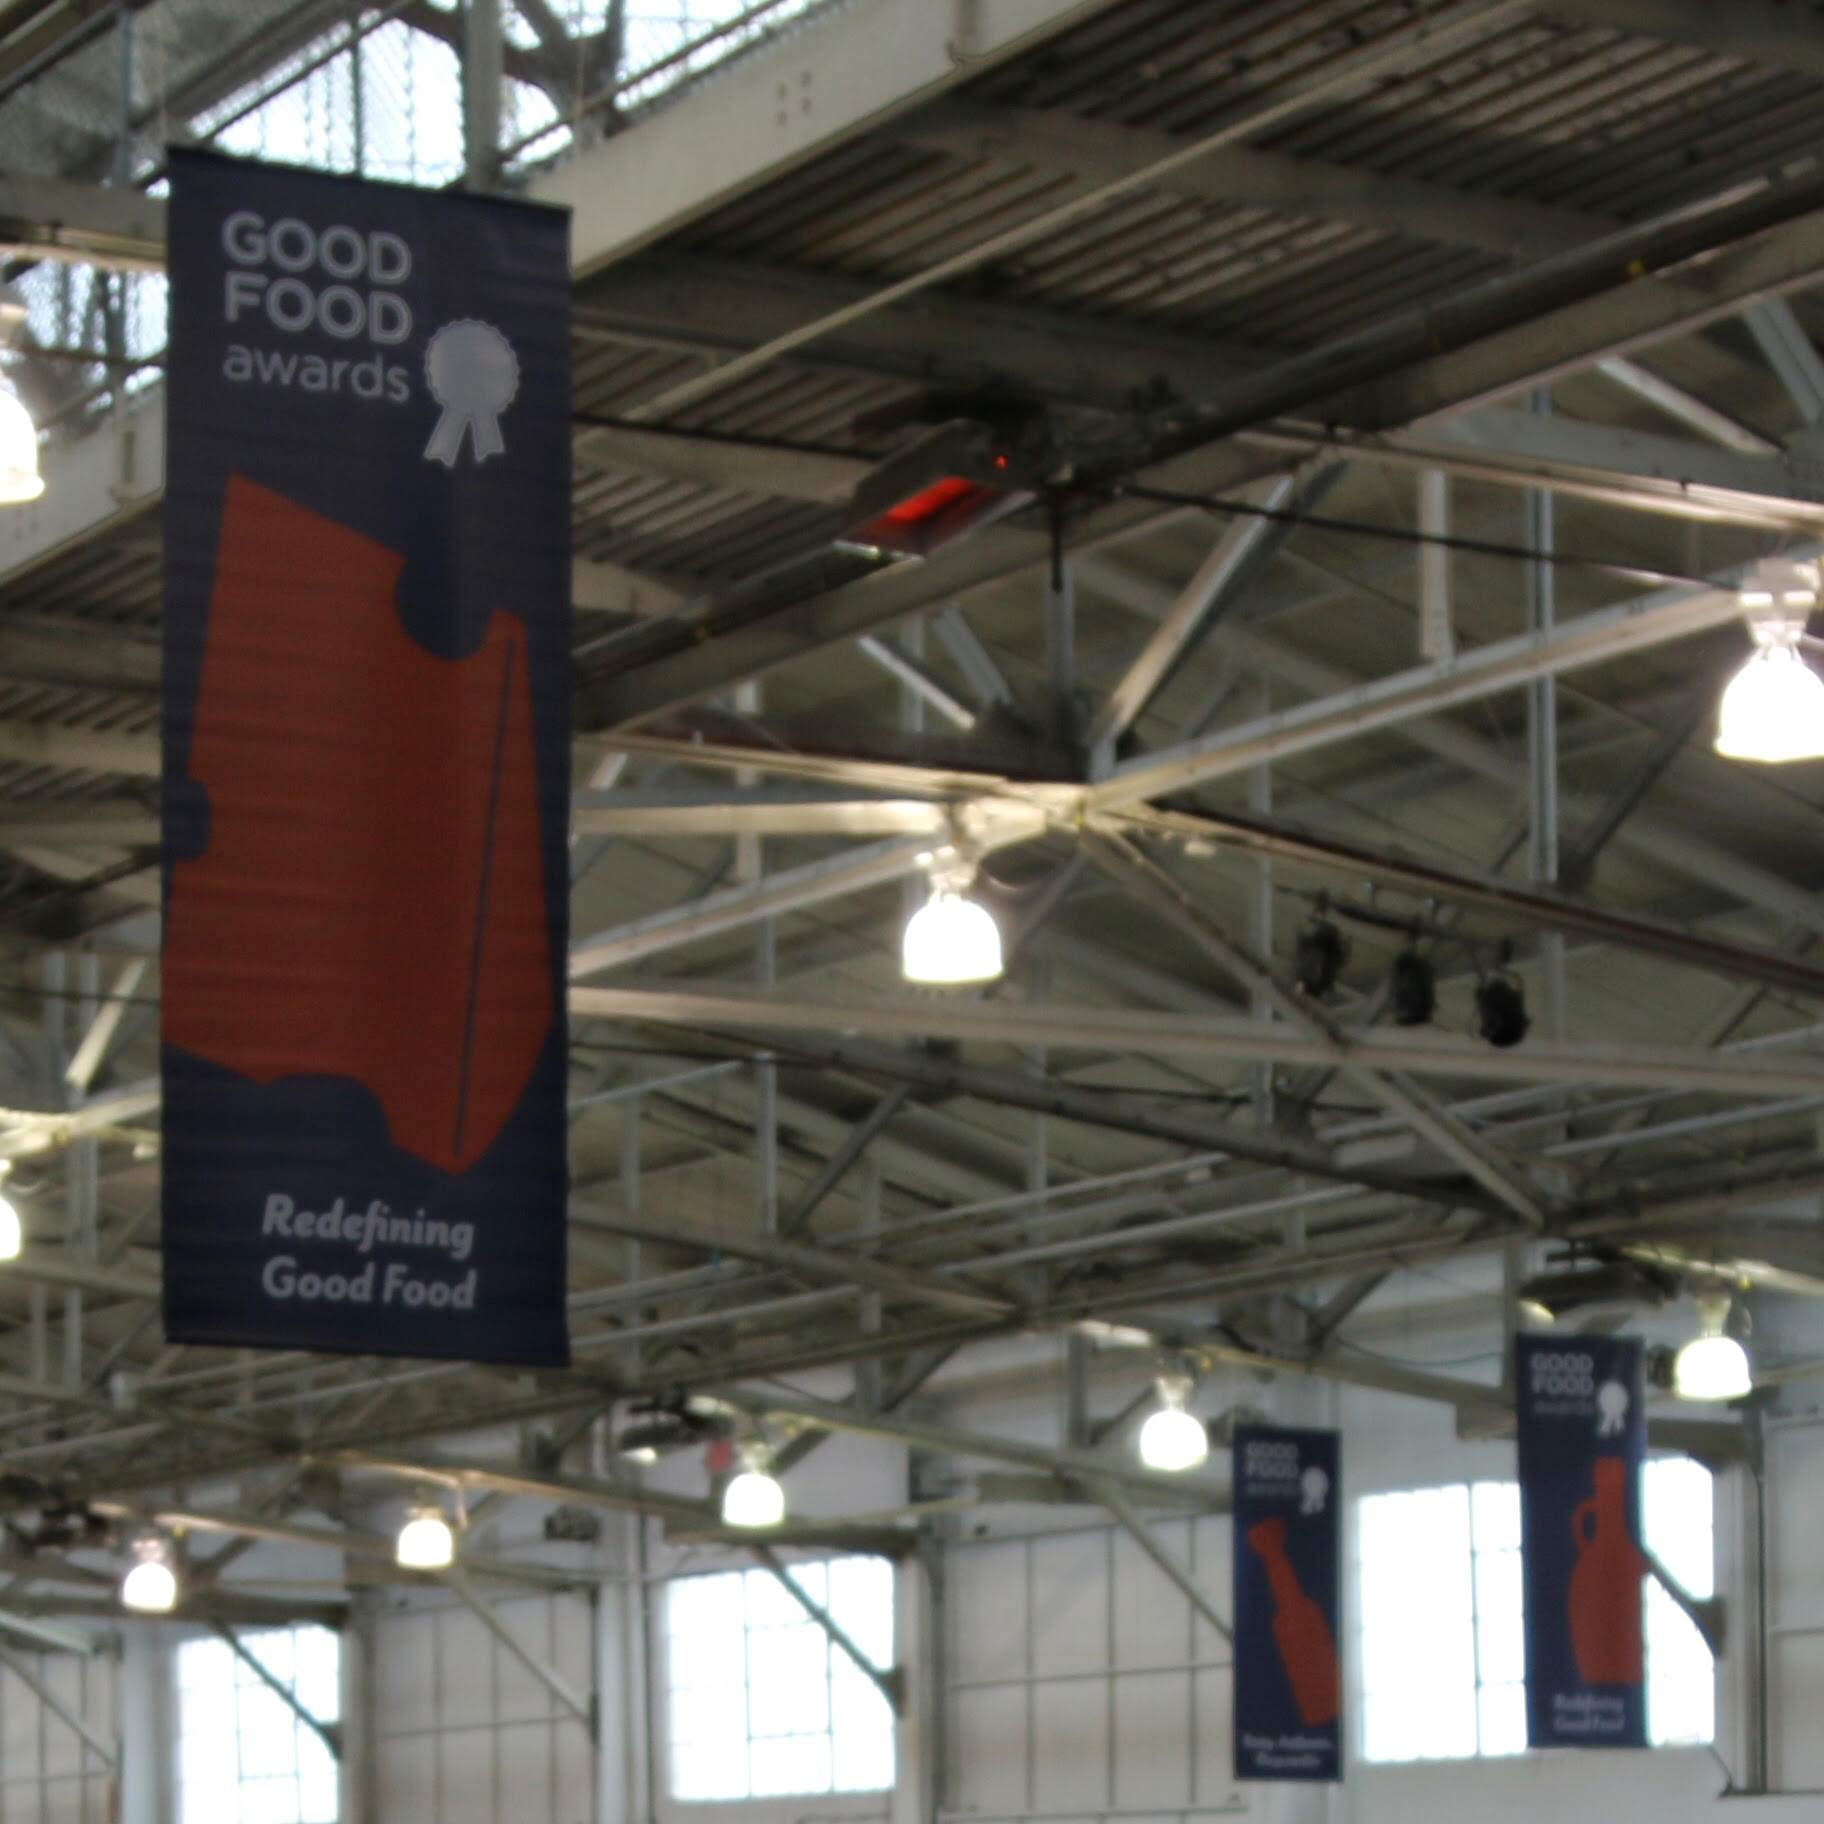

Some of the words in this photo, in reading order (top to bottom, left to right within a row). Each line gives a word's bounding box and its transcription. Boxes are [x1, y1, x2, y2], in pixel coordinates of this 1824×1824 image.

[222, 211, 412, 285] GOOD
[223, 270, 414, 344] FOOD
[223, 344, 410, 403] awards
[262, 1194, 474, 1260] Redefining
[262, 1256, 376, 1304] Good
[383, 1264, 477, 1308] Food
